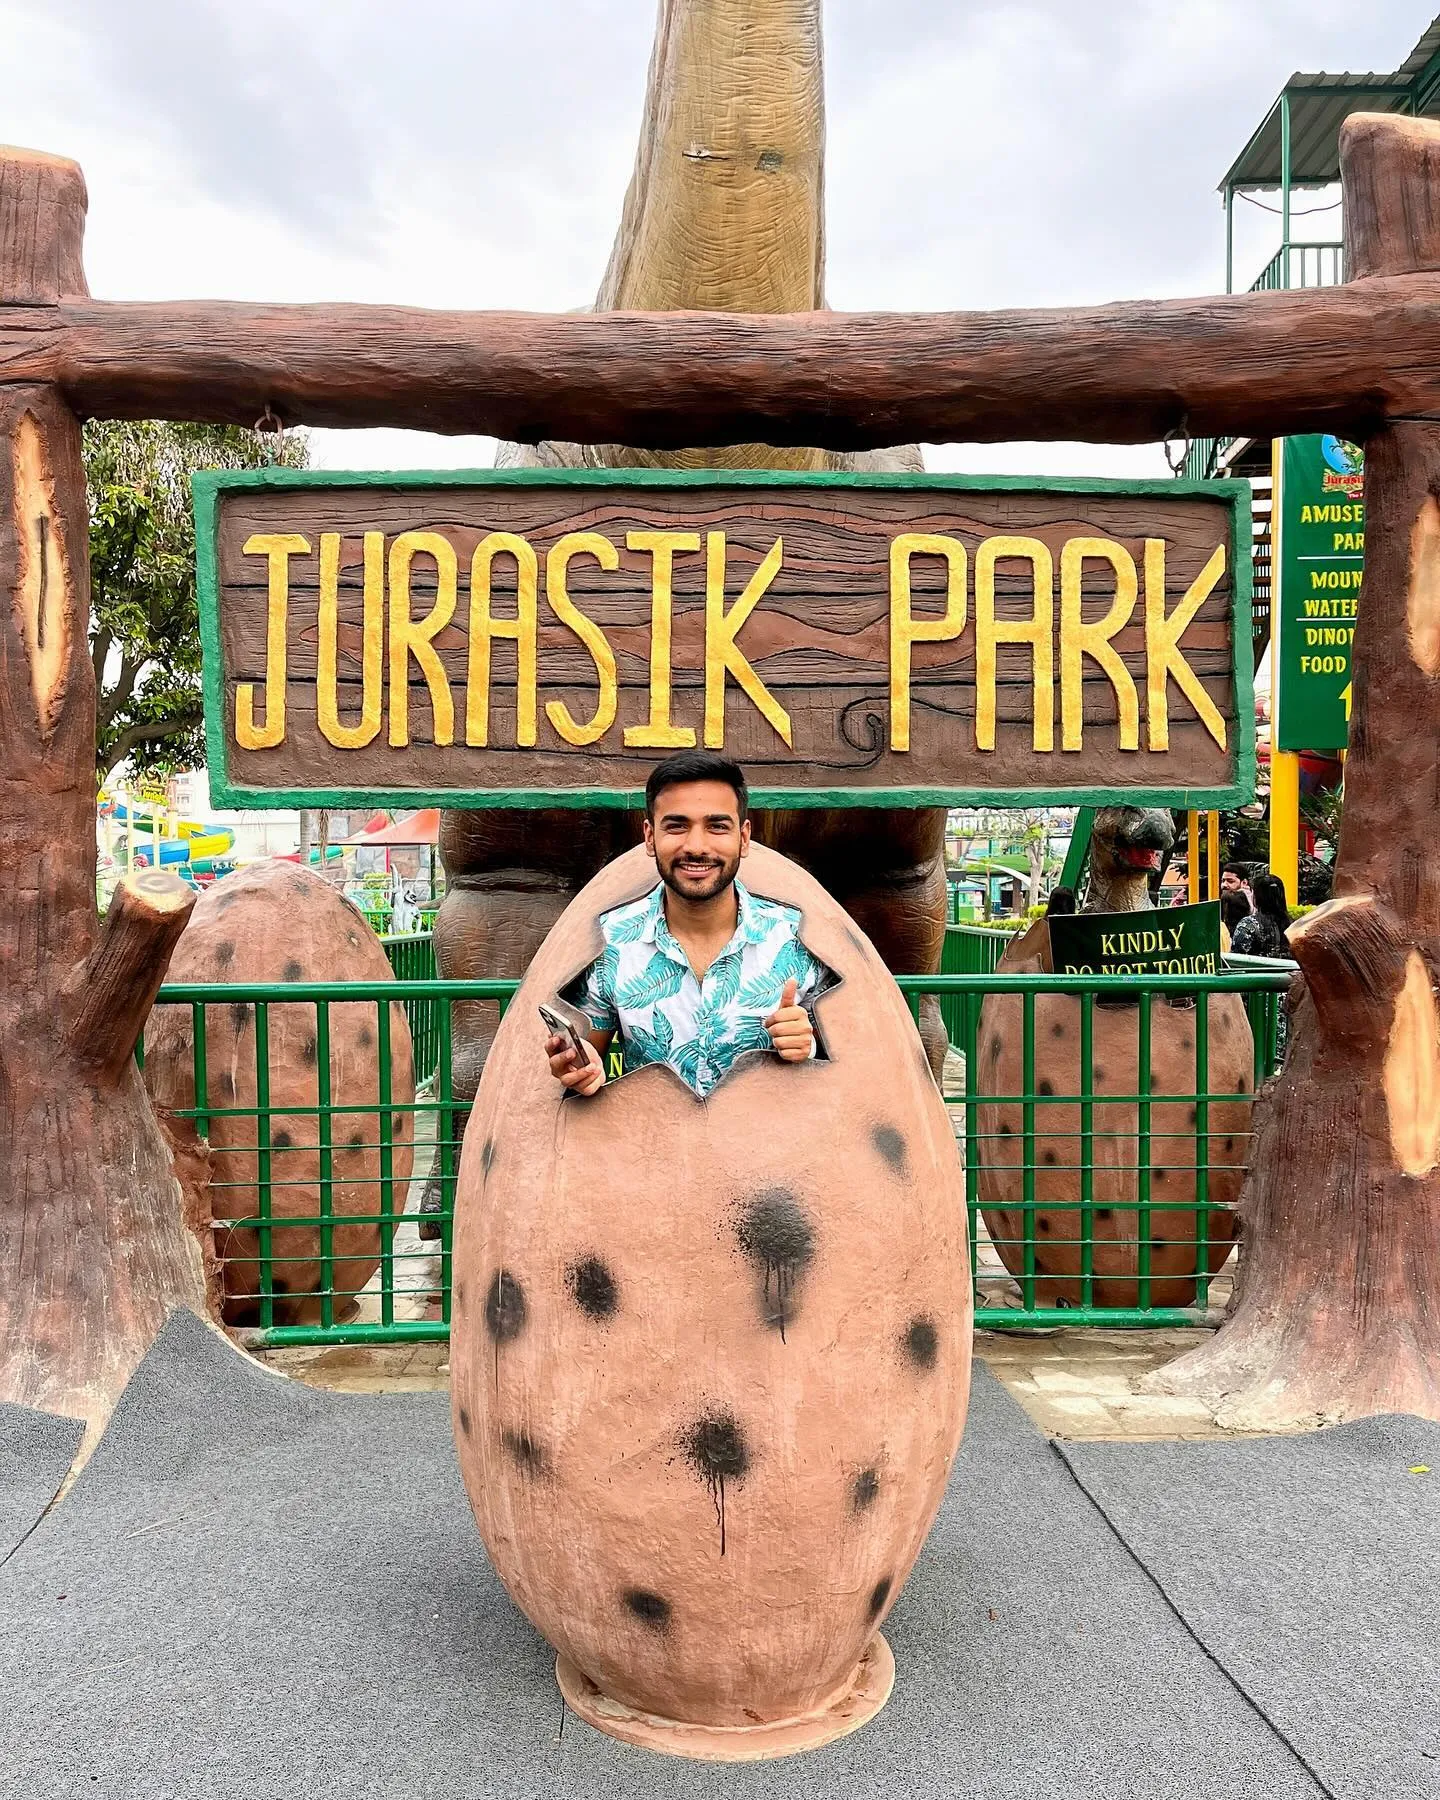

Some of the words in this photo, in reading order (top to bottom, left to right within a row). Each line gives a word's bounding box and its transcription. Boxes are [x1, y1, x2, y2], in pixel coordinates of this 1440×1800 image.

[1300, 504, 1364, 523] AMUSE
[1333, 532, 1364, 551] PAR
[1310, 571, 1363, 590] MOUN
[235, 531, 793, 750] JURASIK
[889, 533, 1227, 753] PARK
[1300, 655, 1347, 674] FOOD
[945, 815, 985, 832] EMENT
[1101, 922, 1185, 956] KINDLY
[1153, 952, 1216, 975] TOUCH
